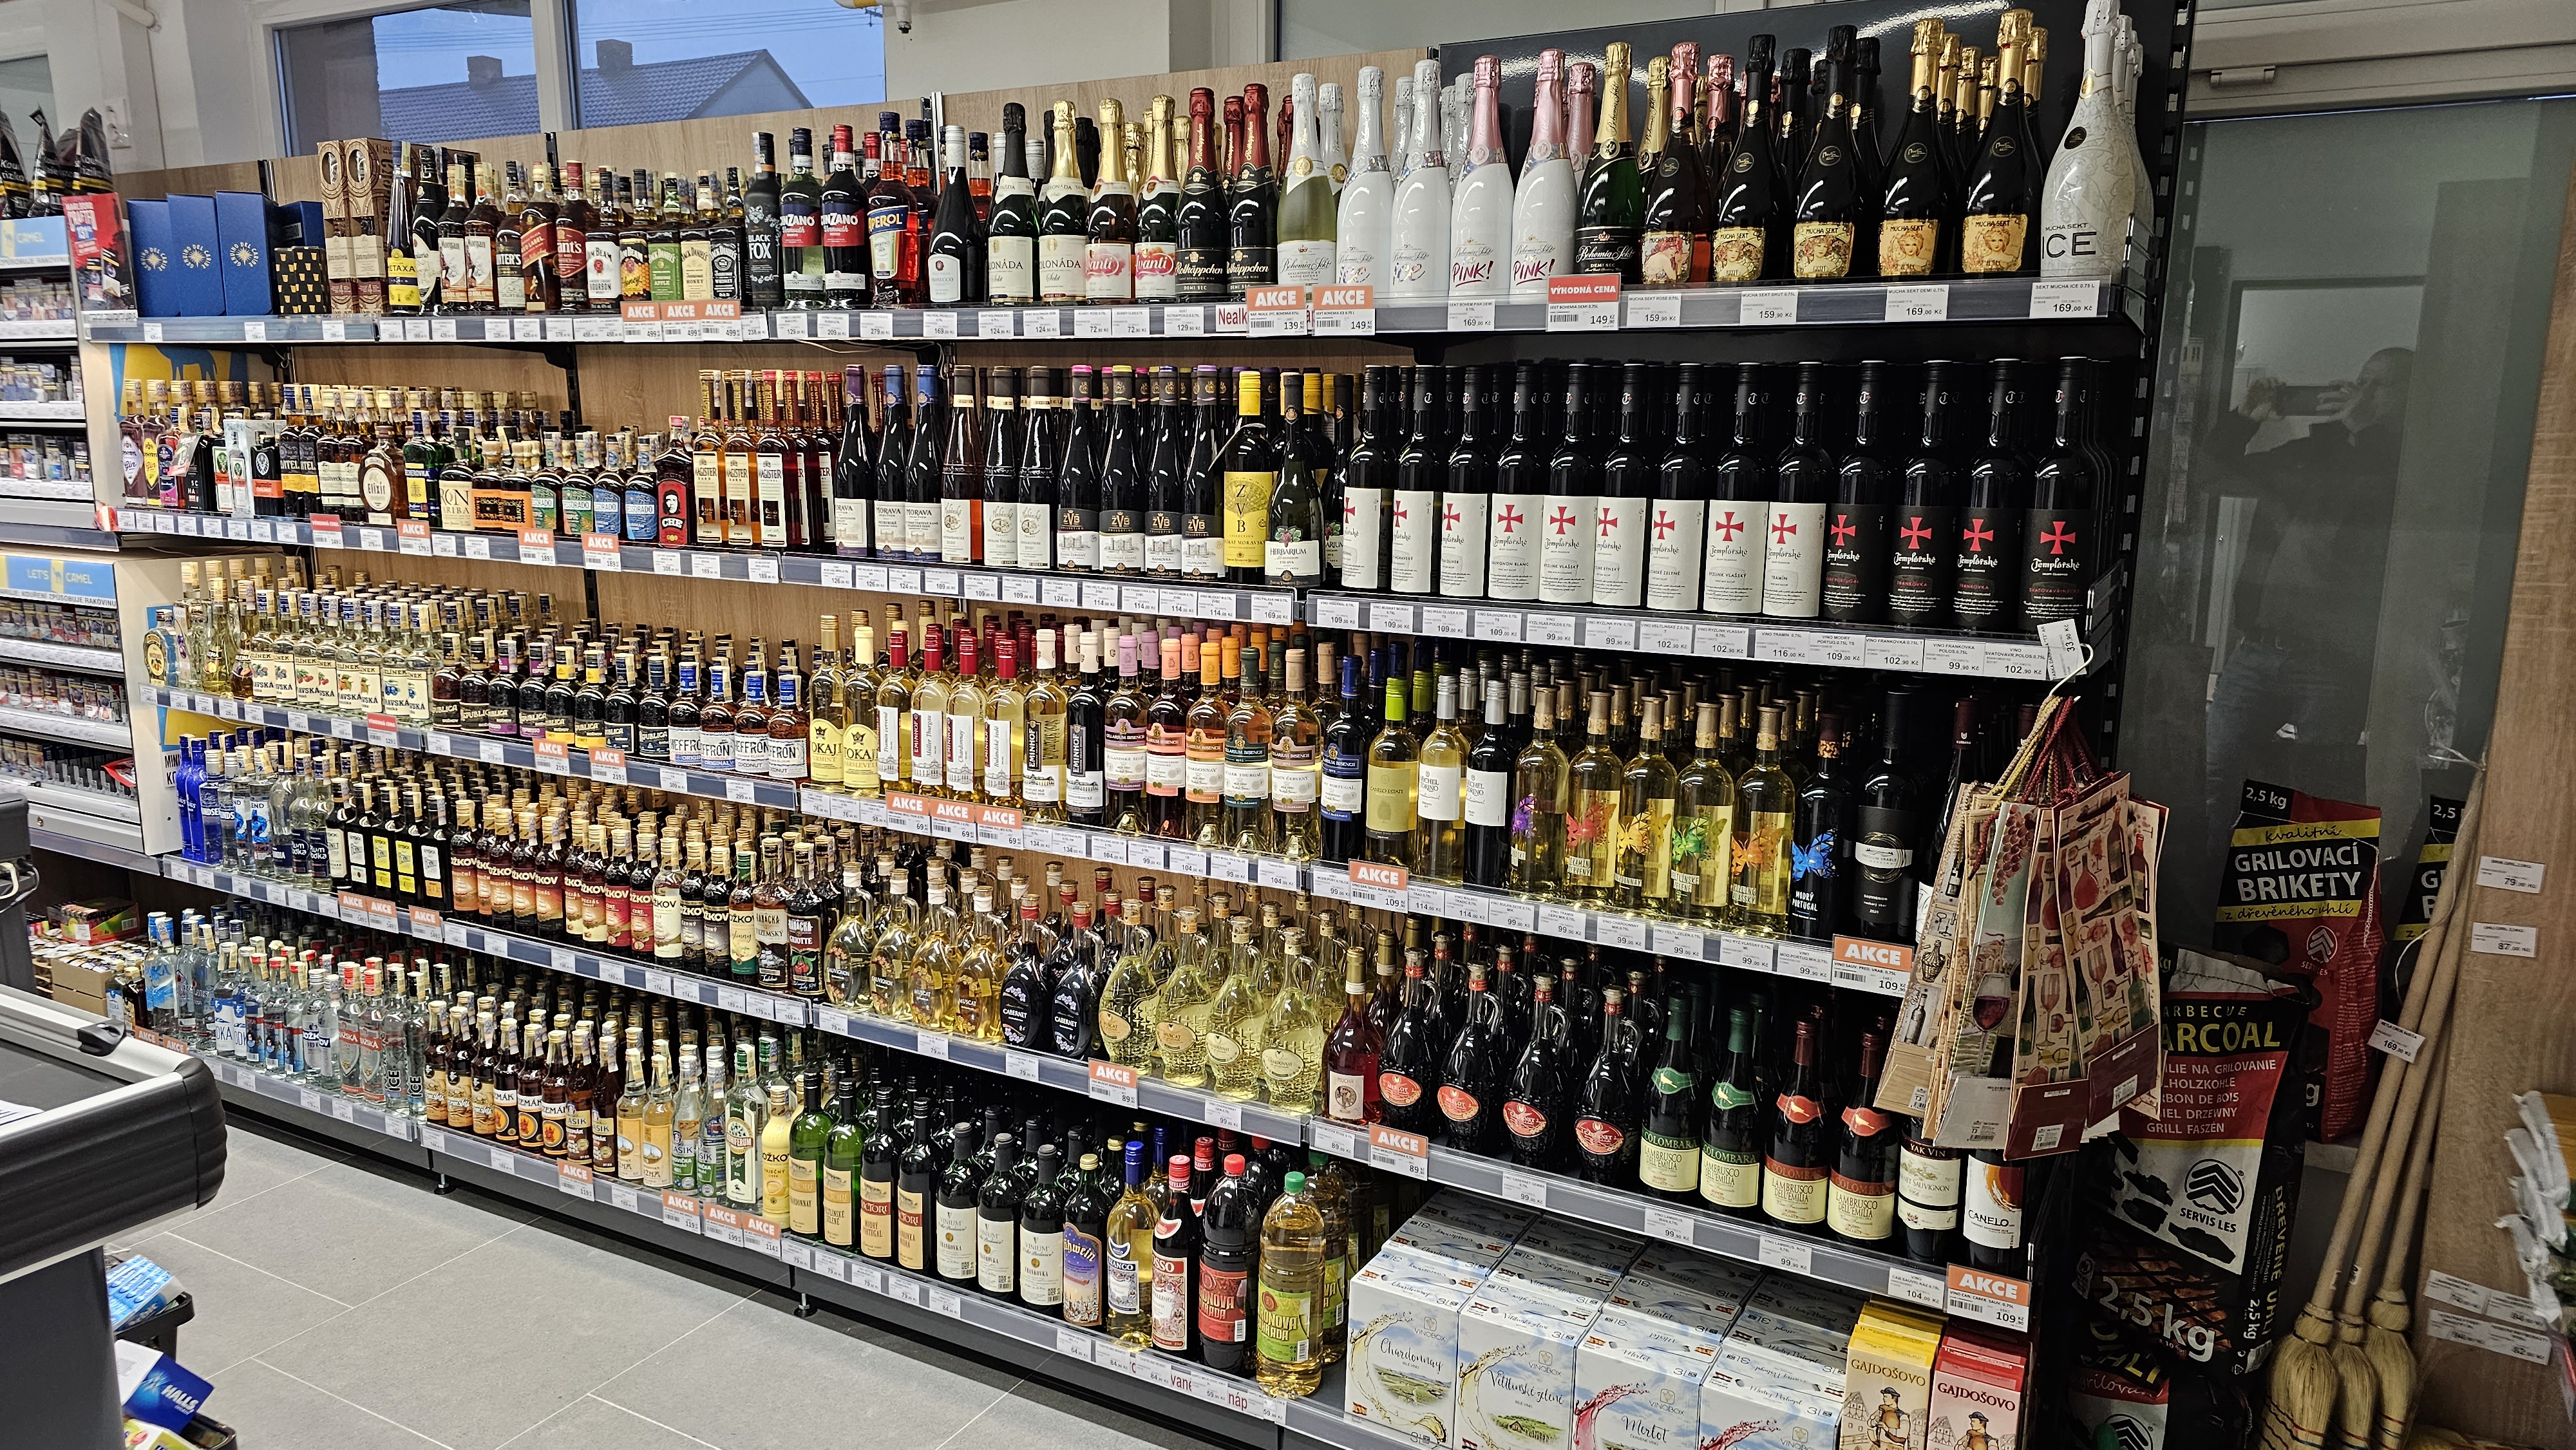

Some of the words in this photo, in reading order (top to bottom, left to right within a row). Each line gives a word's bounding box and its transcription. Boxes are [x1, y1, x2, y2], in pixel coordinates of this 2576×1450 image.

[868, 212, 903, 232] APEROL
[748, 234, 770, 243] BLACK
[2042, 231, 2097, 259] ICE
[748, 242, 772, 259] FOX
[1575, 245, 1614, 263] Bohemia
[1611, 245, 1636, 259] Sekt
[1452, 261, 1493, 281] PINK!
[1513, 258, 1555, 282] PINK!
[1321, 290, 1365, 305] AKCE
[1551, 285, 1591, 294] VÝHODNÁ
[1595, 285, 1616, 294] CENA
[1255, 291, 1296, 306] AKCE
[627, 306, 655, 318] AKCE
[667, 305, 696, 317] AKCE
[705, 304, 735, 316] AKCE
[905, 508, 933, 516] MORAVA
[402, 524, 426, 536] AKCE
[662, 518, 683, 529] CHE
[524, 532, 549, 544] AKCE
[587, 537, 614, 549] AKCE
[1269, 546, 1307, 556] HERBARIUM
[66, 572, 92, 584] CAMEL
[85, 598, 117, 607] RAKOVINU
[2065, 634, 2075, 652] 33,90
[1884, 657, 1909, 665] 102,90
[1949, 662, 1969, 670] 99,90
[2005, 666, 2031, 674] 102,90
[1028, 728, 1037, 768] EMINHOF
[892, 797, 923, 813] AKCE
[2246, 787, 2267, 803] 2,5
[2269, 792, 2287, 809] kg
[937, 804, 969, 819] AKCE
[983, 810, 1016, 826] AKCE
[2434, 804, 2456, 818] 2,5
[2265, 825, 2342, 844] kvalitní
[2234, 842, 2360, 873] GRILOVACÍ
[1358, 867, 1398, 885] AKCE
[2237, 871, 2361, 902] BRIKETY
[343, 894, 364, 908] AKCE
[1795, 890, 1814, 902] MODRÝ
[371, 901, 392, 914] AKCE
[1792, 900, 1817, 912] PORTUGAL
[2237, 904, 2318, 919] dřevěného
[2319, 901, 2354, 916] uhlí
[413, 910, 437, 924] AKCE
[1844, 944, 1901, 966] AKCE
[959, 998, 976, 1007] MUSCAT
[1003, 1008, 1027, 1019] CABERNET
[2163, 1006, 2247, 1017] ARBECUE
[1055, 1015, 1077, 1028] CABERNET
[2162, 1021, 2280, 1053] ARCOAL
[1096, 1065, 1130, 1084] AKCE
[2192, 1064, 2209, 1074] NA
[2215, 1060, 2276, 1074] GRILOVANIE
[388, 1069, 400, 1093] ICE
[410, 1075, 422, 1098] ICE
[2199, 1095, 2213, 1104] DE
[2217, 1093, 2239, 1103] BOIS
[2186, 1107, 2237, 1119] DRZEWNY
[2146, 1122, 2183, 1135] GRILL
[2187, 1120, 2225, 1134] FASZÉN
[1378, 1131, 1419, 1152] AKCE
[1644, 1133, 1697, 1149] COLOMBARA
[1644, 1147, 1682, 1163] LAMBRUSCO
[1909, 1142, 1925, 1154] YAK
[1927, 1147, 1947, 1158] VIN
[1647, 1156, 1677, 1171] DELL'EMILIA
[1704, 1162, 1739, 1177] LAMBRUSCO
[562, 1164, 588, 1180] AKCE
[1705, 1171, 1734, 1185] DELL'EMILIA
[1772, 1178, 1813, 1194] LAMBRUSCO
[1913, 1179, 1950, 1194] SAUVIGNON
[1775, 1188, 1808, 1202] DELL'EMILIA
[1835, 1192, 1878, 1209] LAMBRUSCO
[668, 1196, 694, 1212] AKCE
[1838, 1202, 1873, 1218] DELL'EMILIA
[709, 1209, 736, 1225] AKCE
[1968, 1209, 2009, 1227] CANELO
[2179, 1207, 2216, 1227] SERVIS
[2217, 1220, 2237, 1234] LES
[748, 1219, 775, 1236] AKCE
[1959, 1273, 2018, 1299] AKCE
[1907, 1290, 1930, 1301] 104,00
[2099, 1276, 2152, 1328] 2,5
[2163, 1303, 2215, 1362] kg
[1414, 1327, 1446, 1342] VINOBOX
[1381, 1337, 1444, 1371] Chardonnay
[1528, 1362, 1561, 1377] VINOBOX
[1851, 1357, 1926, 1386] GAJDOŠOVO
[162, 1383, 199, 1412] HALLS
[1937, 1382, 2016, 1412] GAJDOŠOVO
[1649, 1400, 1685, 1416] VINOBOX
[1621, 1415, 1670, 1444] Merlot
